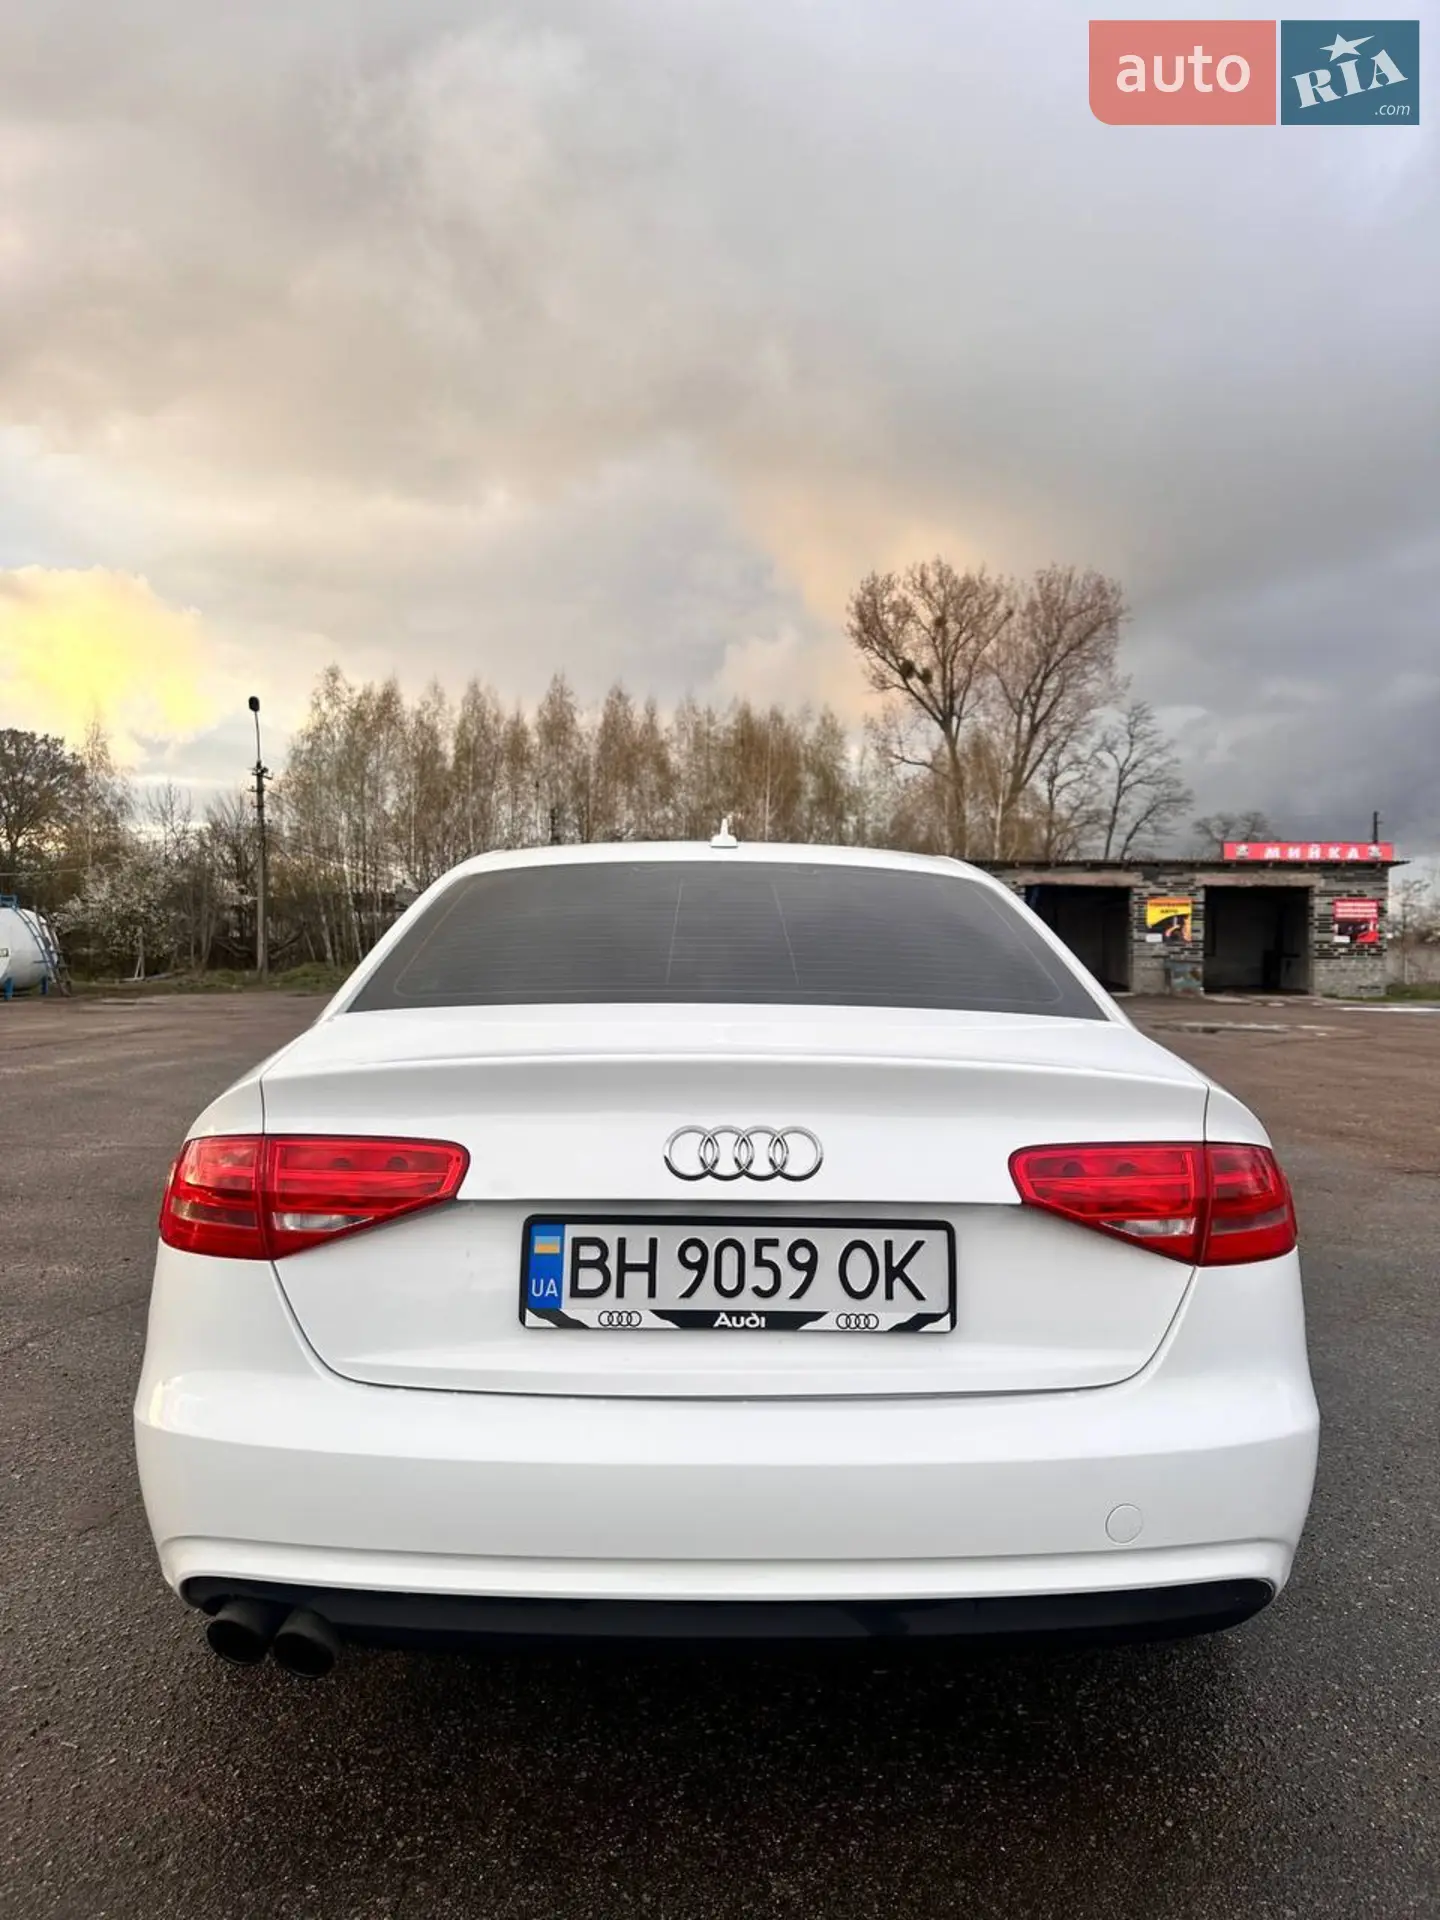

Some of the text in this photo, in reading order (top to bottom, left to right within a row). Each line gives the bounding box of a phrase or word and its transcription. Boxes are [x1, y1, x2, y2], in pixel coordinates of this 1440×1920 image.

[1263, 843, 1360, 859] МИЙКА
[569, 1236, 926, 1301] BH 9059 OK
[531, 1278, 559, 1297] UA
[713, 1311, 766, 1328] Audi
